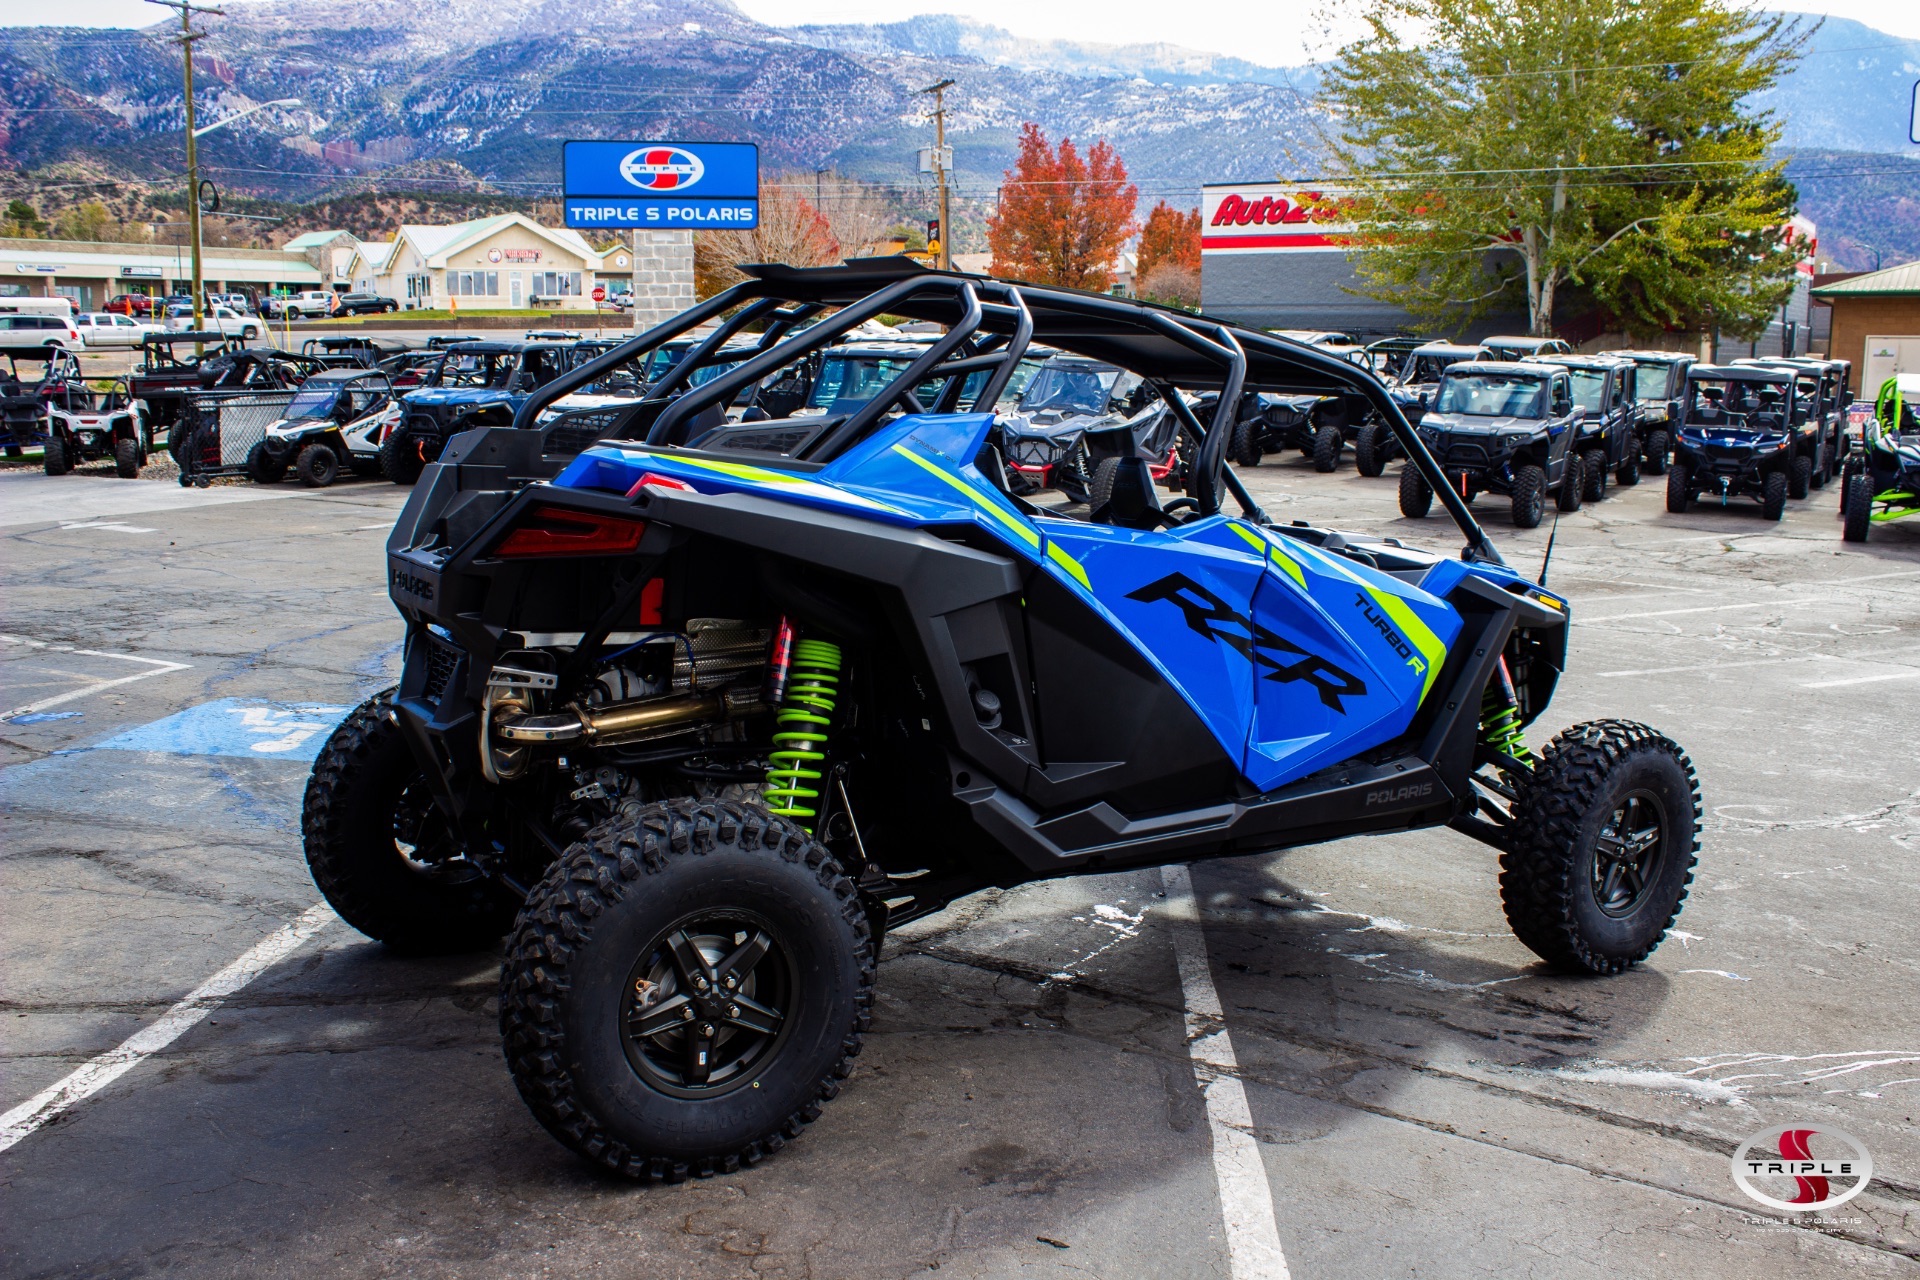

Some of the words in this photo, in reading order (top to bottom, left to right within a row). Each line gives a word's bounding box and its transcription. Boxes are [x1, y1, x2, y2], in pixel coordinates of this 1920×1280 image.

[570, 207, 639, 221] TRIPLE
[645, 207, 660, 221] S
[667, 207, 753, 221] POLARIS
[346, 418, 376, 436] RZR
[392, 568, 434, 601] POLARIS
[1123, 571, 1368, 716] RZR
[1354, 593, 1413, 660] TURBO
[1406, 657, 1427, 677] R
[1365, 782, 1433, 806] POLARIS
